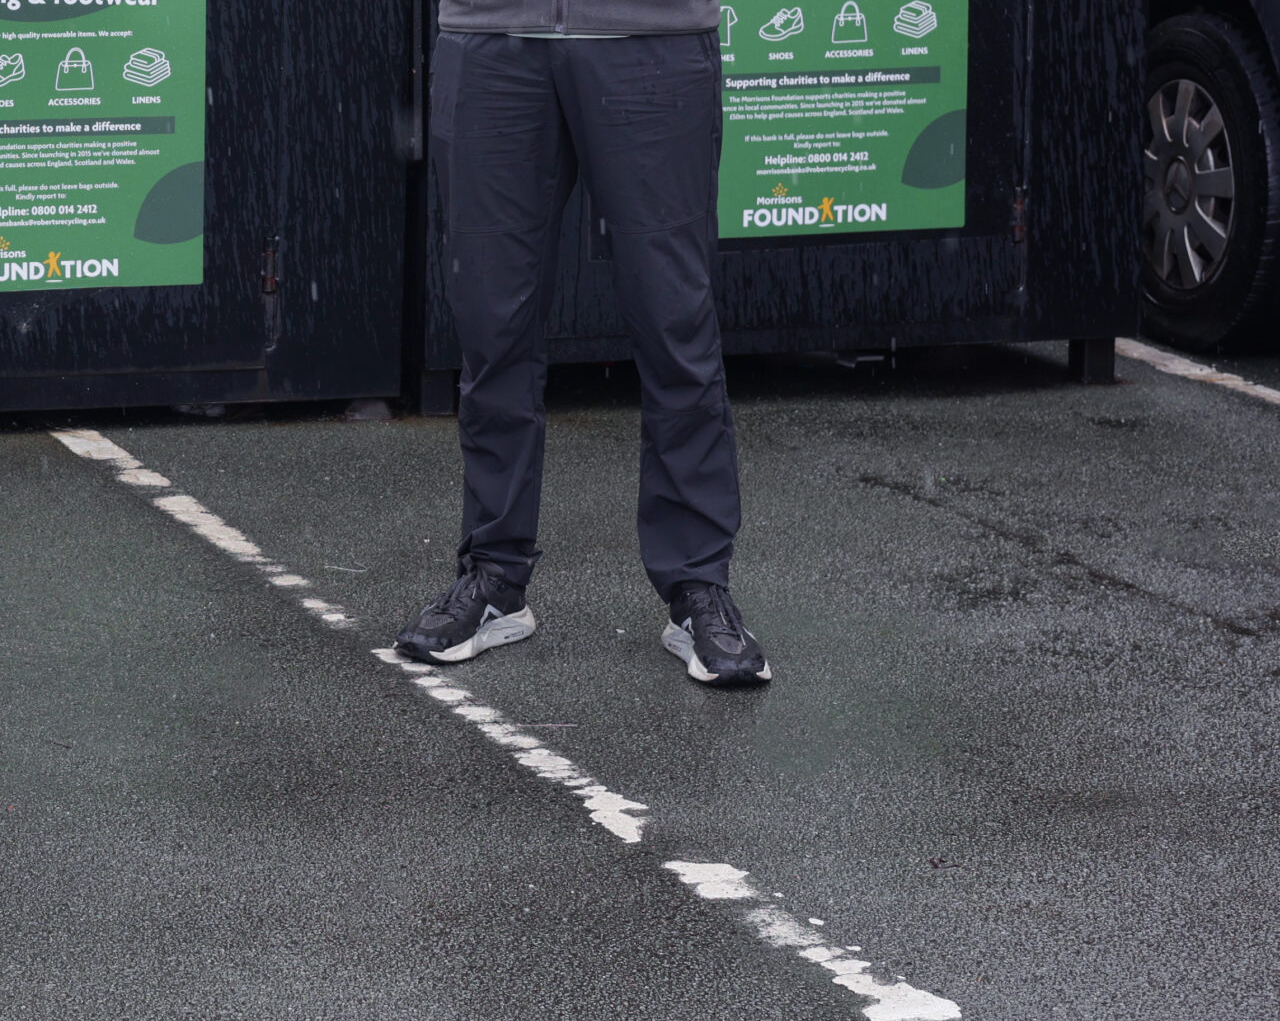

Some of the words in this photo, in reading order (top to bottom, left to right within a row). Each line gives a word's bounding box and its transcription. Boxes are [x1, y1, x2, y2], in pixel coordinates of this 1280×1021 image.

[824, 49, 874, 58] ACCESSORIES
[901, 47, 929, 56] LINENS
[768, 52, 794, 61] SHOES
[47, 98, 102, 106] ACCESSORIES
[131, 96, 162, 105] LINENS
[41, 125, 54, 133] to
[55, 122, 82, 132] make
[91, 121, 142, 131] difference
[764, 155, 807, 166] Helpline:
[807, 153, 832, 163] 0800
[832, 153, 848, 162] 014
[849, 152, 869, 161] 2412
[756, 196, 803, 205] Morrisons
[31, 206, 57, 215] 0800
[57, 205, 75, 214] 014
[76, 204, 98, 214] 2412
